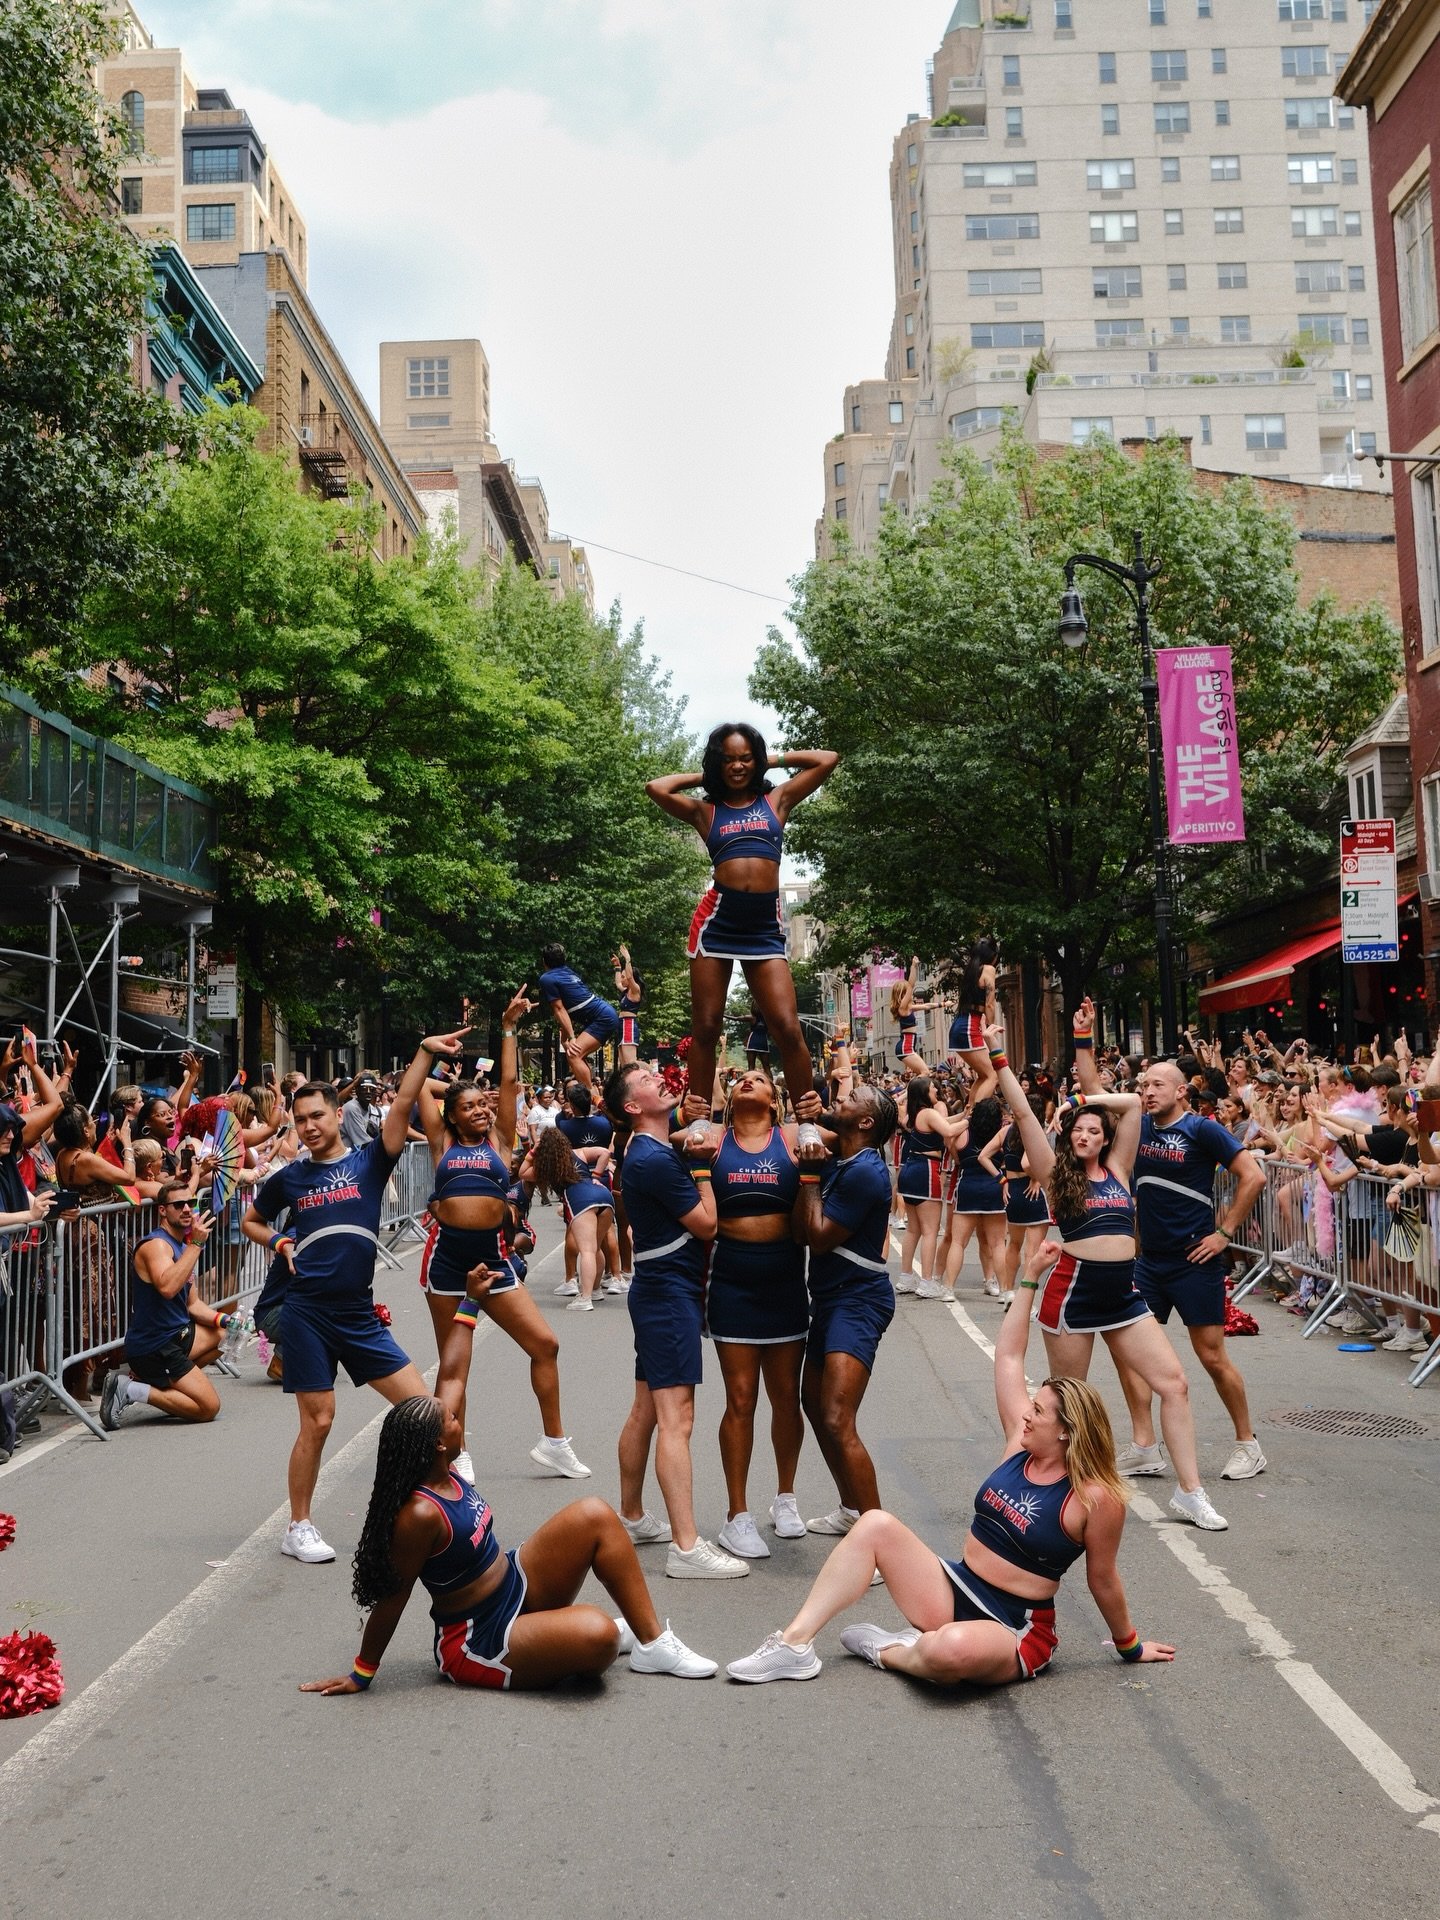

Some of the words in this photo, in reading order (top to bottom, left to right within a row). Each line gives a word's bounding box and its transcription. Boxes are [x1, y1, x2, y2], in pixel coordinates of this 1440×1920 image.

[1174, 659, 1216, 669] ALLIANCE
[1177, 652, 1211, 662] VILLAGE
[1209, 670, 1231, 702] gay
[1215, 709, 1233, 731] so
[1196, 674, 1230, 806] VILLAGE
[1176, 744, 1205, 808] THE
[720, 823, 742, 837] NEW
[743, 820, 770, 832] YORK
[1177, 821, 1236, 835] APERITIVO
[1365, 822, 1392, 830] STANDING
[1346, 891, 1356, 907] 2
[1345, 950, 1384, 960] 104525
[1139, 1144, 1158, 1159] NEW
[1157, 1148, 1185, 1163] YORK
[447, 1159, 467, 1170] NEW
[467, 1160, 491, 1171] YORK
[728, 1172, 750, 1184] NEW
[751, 1173, 779, 1185] YORK
[308, 1181, 344, 1195] CHEER
[297, 1193, 325, 1212] NEW
[324, 1184, 361, 1204] YORK
[1085, 1198, 1106, 1209] NEW
[1106, 1198, 1129, 1209] YORK
[997, 1489, 1026, 1514] CHEER
[982, 1487, 1007, 1513] NEW
[1002, 1504, 1032, 1535] YORK
